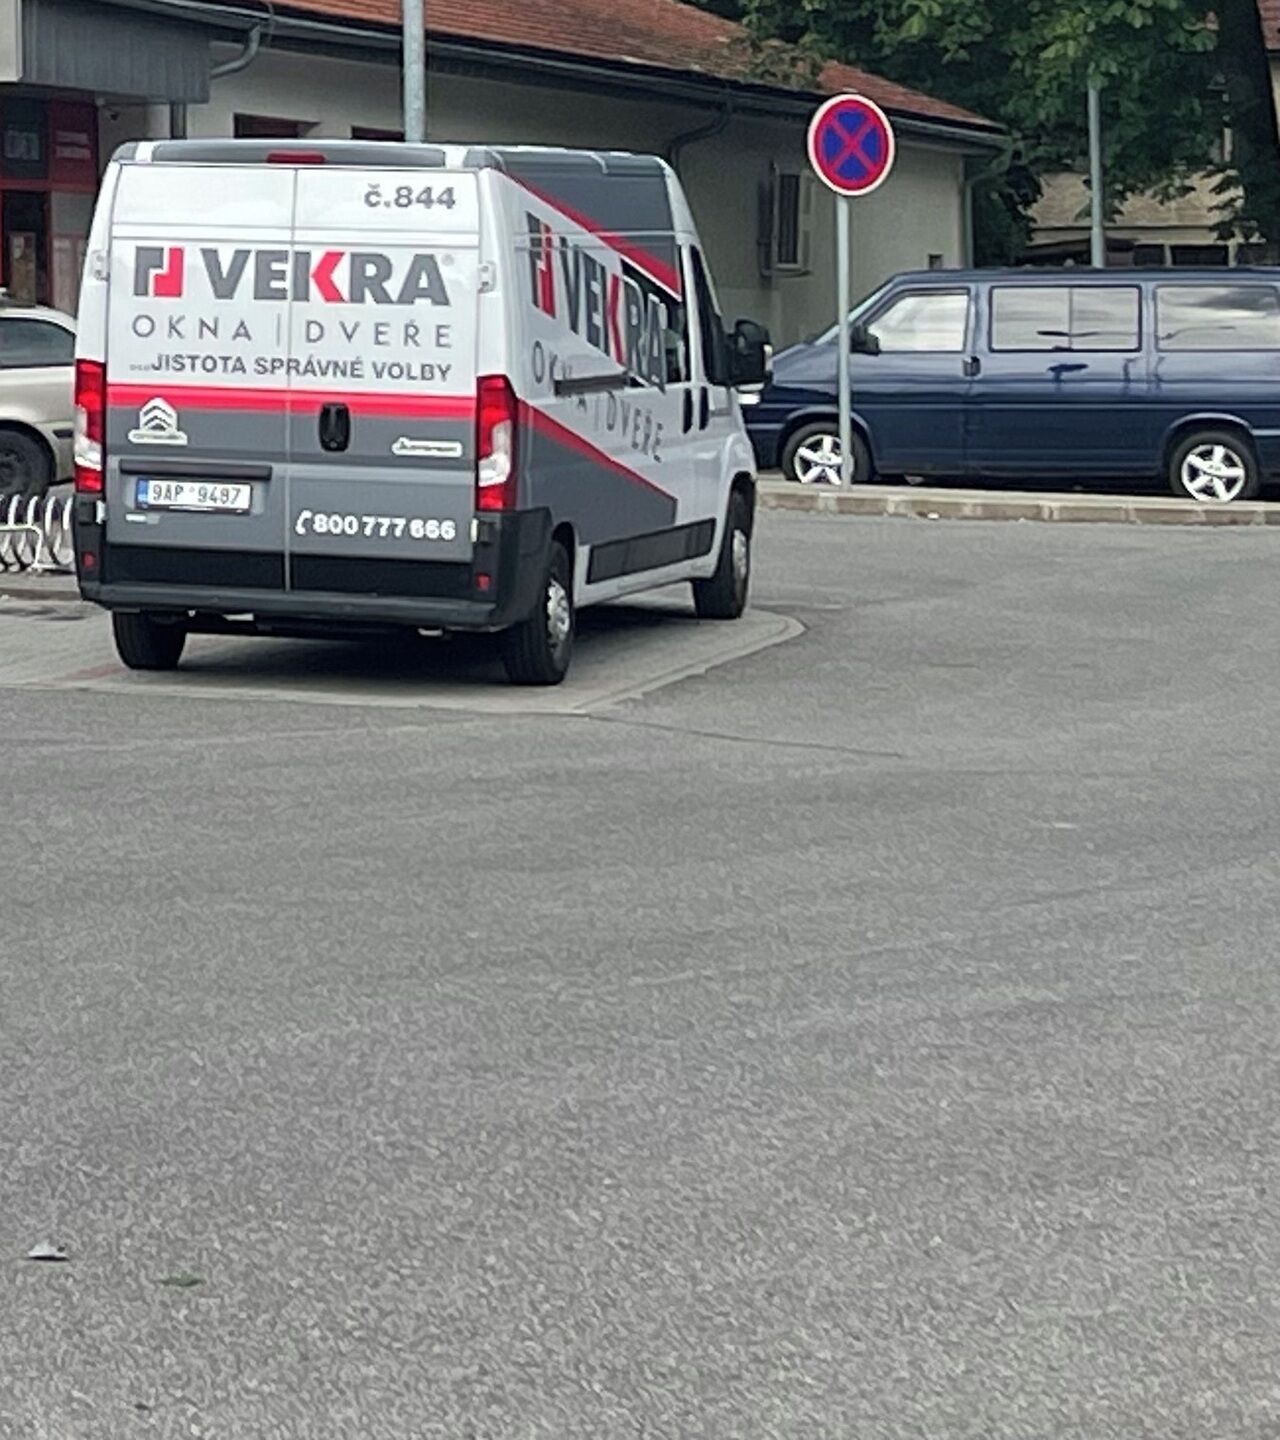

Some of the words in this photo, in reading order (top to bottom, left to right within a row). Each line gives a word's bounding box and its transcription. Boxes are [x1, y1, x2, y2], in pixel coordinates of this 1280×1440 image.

[364, 183, 457, 210] č.844
[200, 247, 451, 307] VEKRA
[132, 314, 253, 342] OKNA
[305, 320, 453, 348] DVEŘE
[253, 356, 365, 380] SPRÁVNÉ
[371, 361, 453, 383] VOLBY
[151, 481, 185, 503] 9AP
[313, 515, 363, 536] 800
[363, 517, 408, 539] 777
[408, 518, 457, 541] 666
